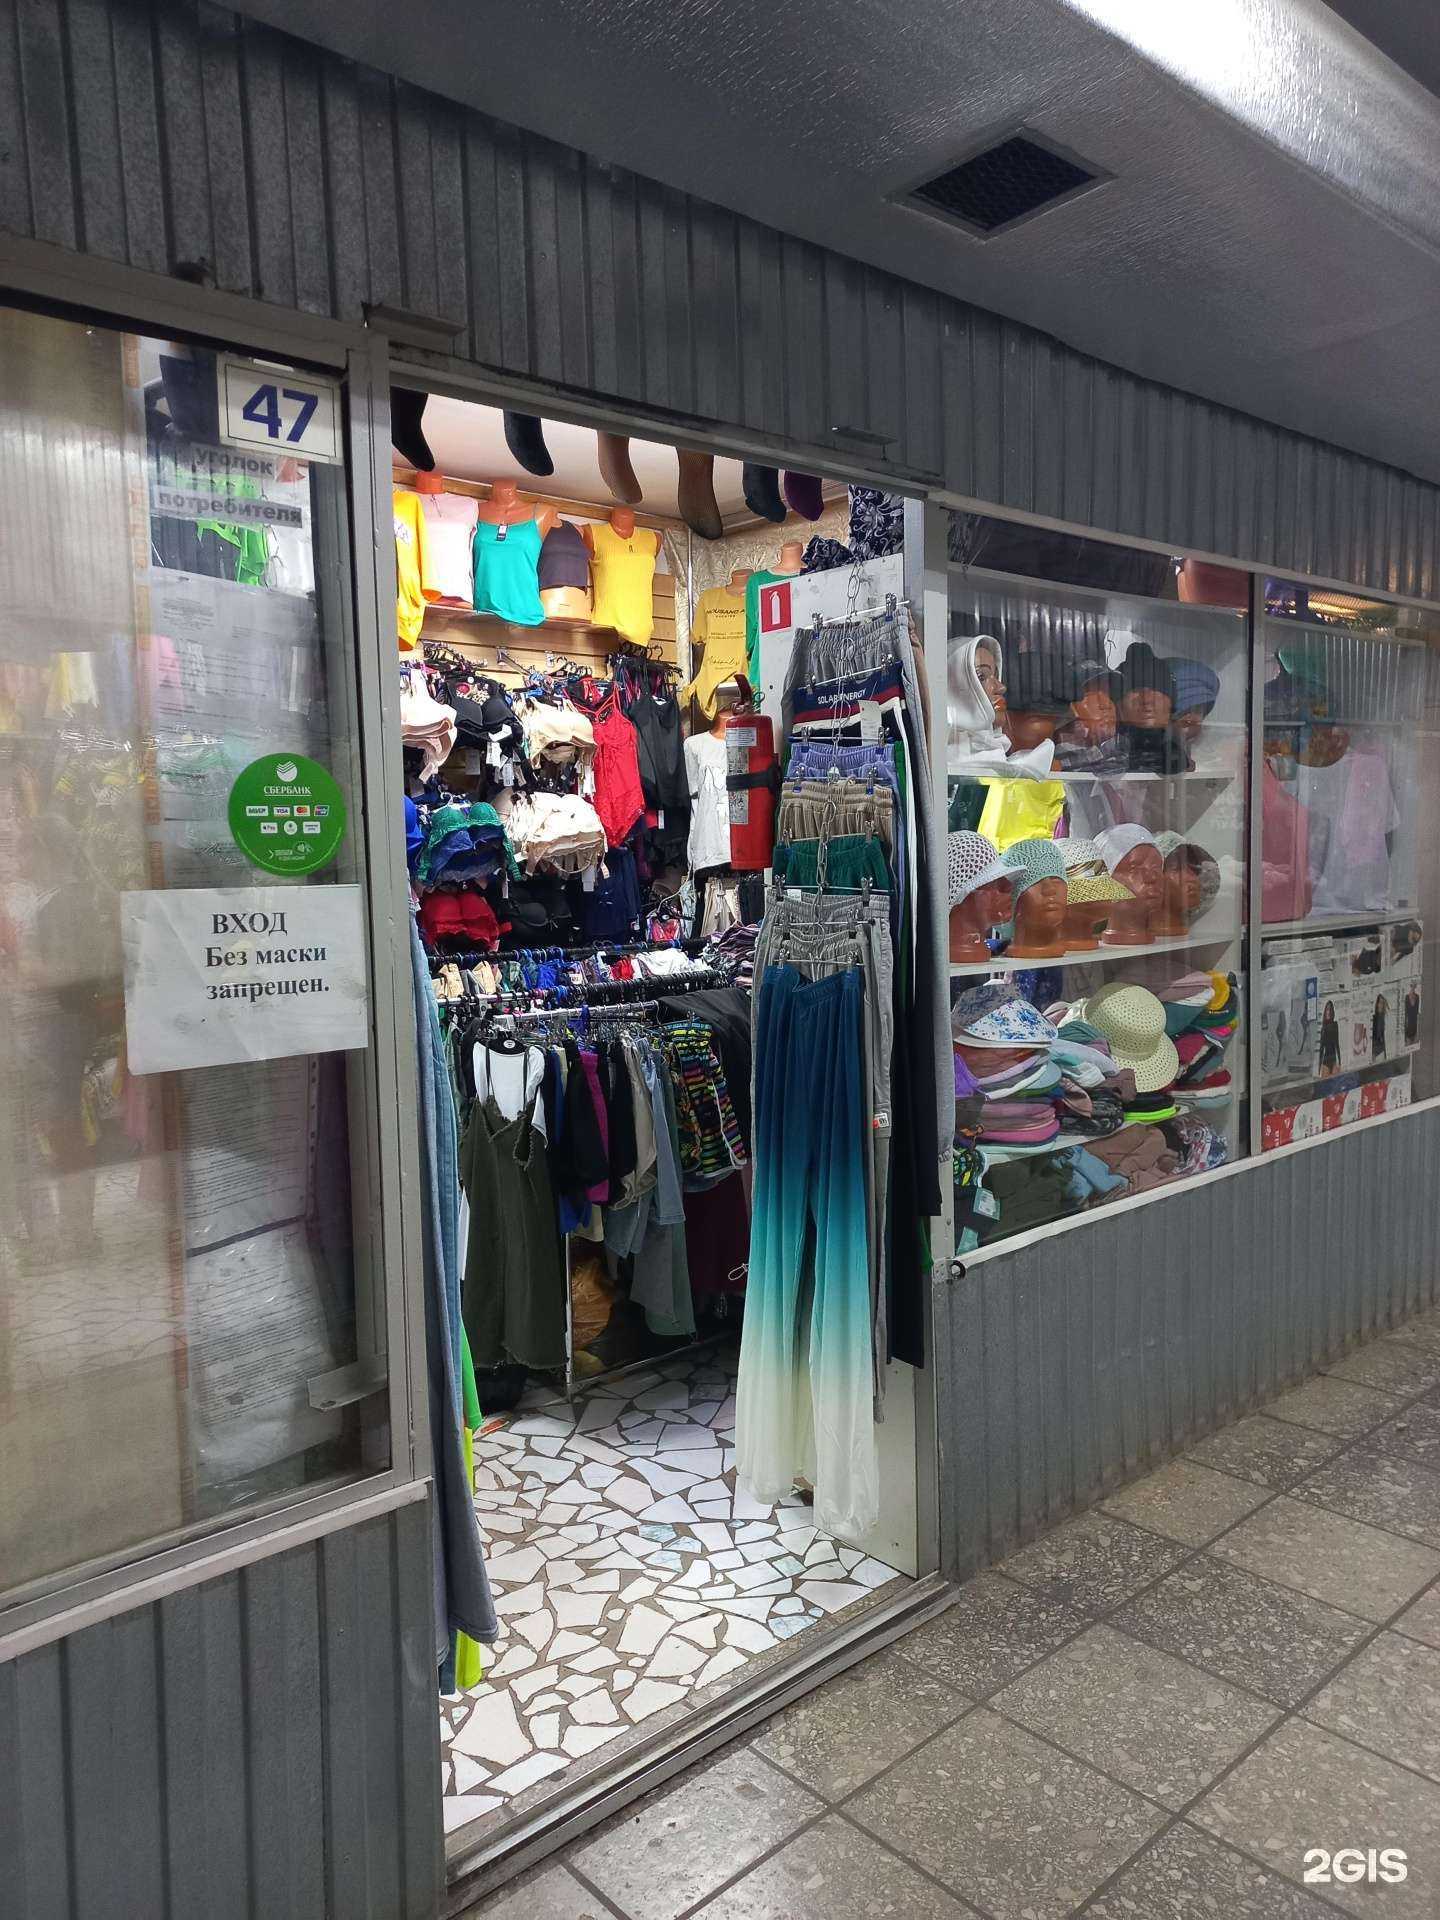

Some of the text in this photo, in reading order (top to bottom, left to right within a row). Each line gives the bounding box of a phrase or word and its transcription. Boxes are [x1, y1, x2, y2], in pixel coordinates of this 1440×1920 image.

[243, 384, 318, 443] 47
[159, 493, 302, 523] потребителя
[817, 694, 839, 704] SOLAR
[263, 785, 312, 795] СБЕРБАНК
[212, 911, 288, 936] ВХОД
[205, 946, 328, 967] Без маски
[206, 978, 330, 1002] запрещен.
